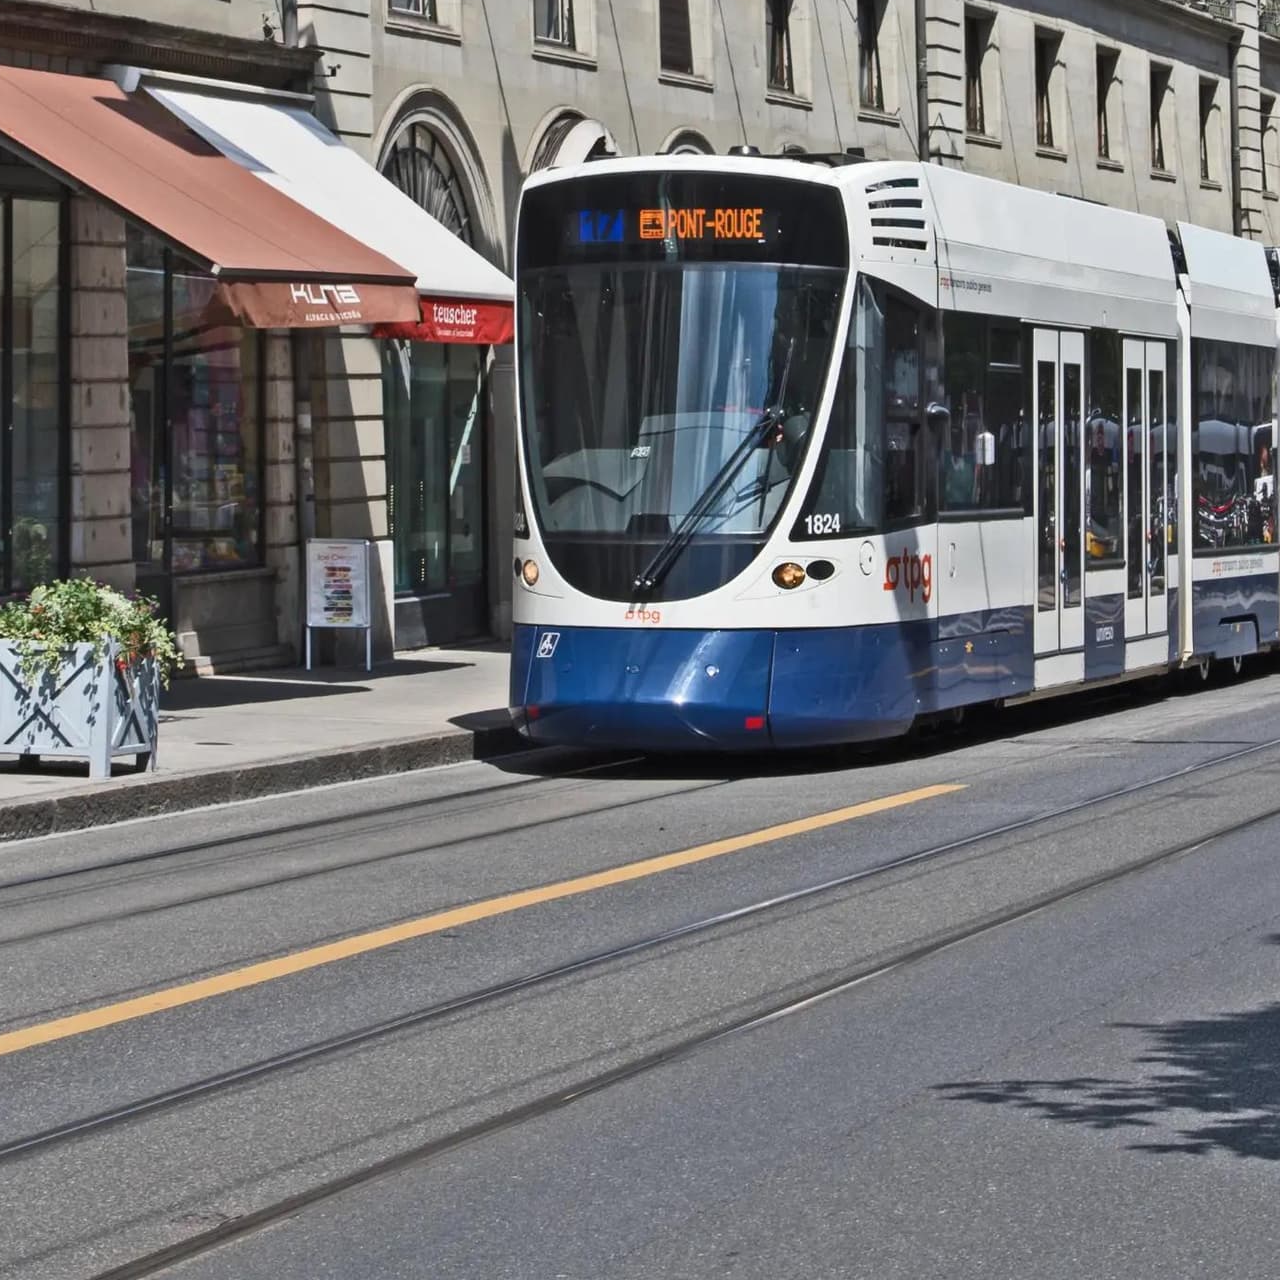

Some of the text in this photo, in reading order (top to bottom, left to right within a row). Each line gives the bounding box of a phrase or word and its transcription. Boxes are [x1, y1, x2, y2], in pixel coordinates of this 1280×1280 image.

[670, 208, 764, 239] PONT-ROUGE
[433, 303, 478, 325] teuscher
[805, 513, 841, 535] 1824
[903, 547, 932, 604] tpg
[637, 609, 661, 624] tpg
